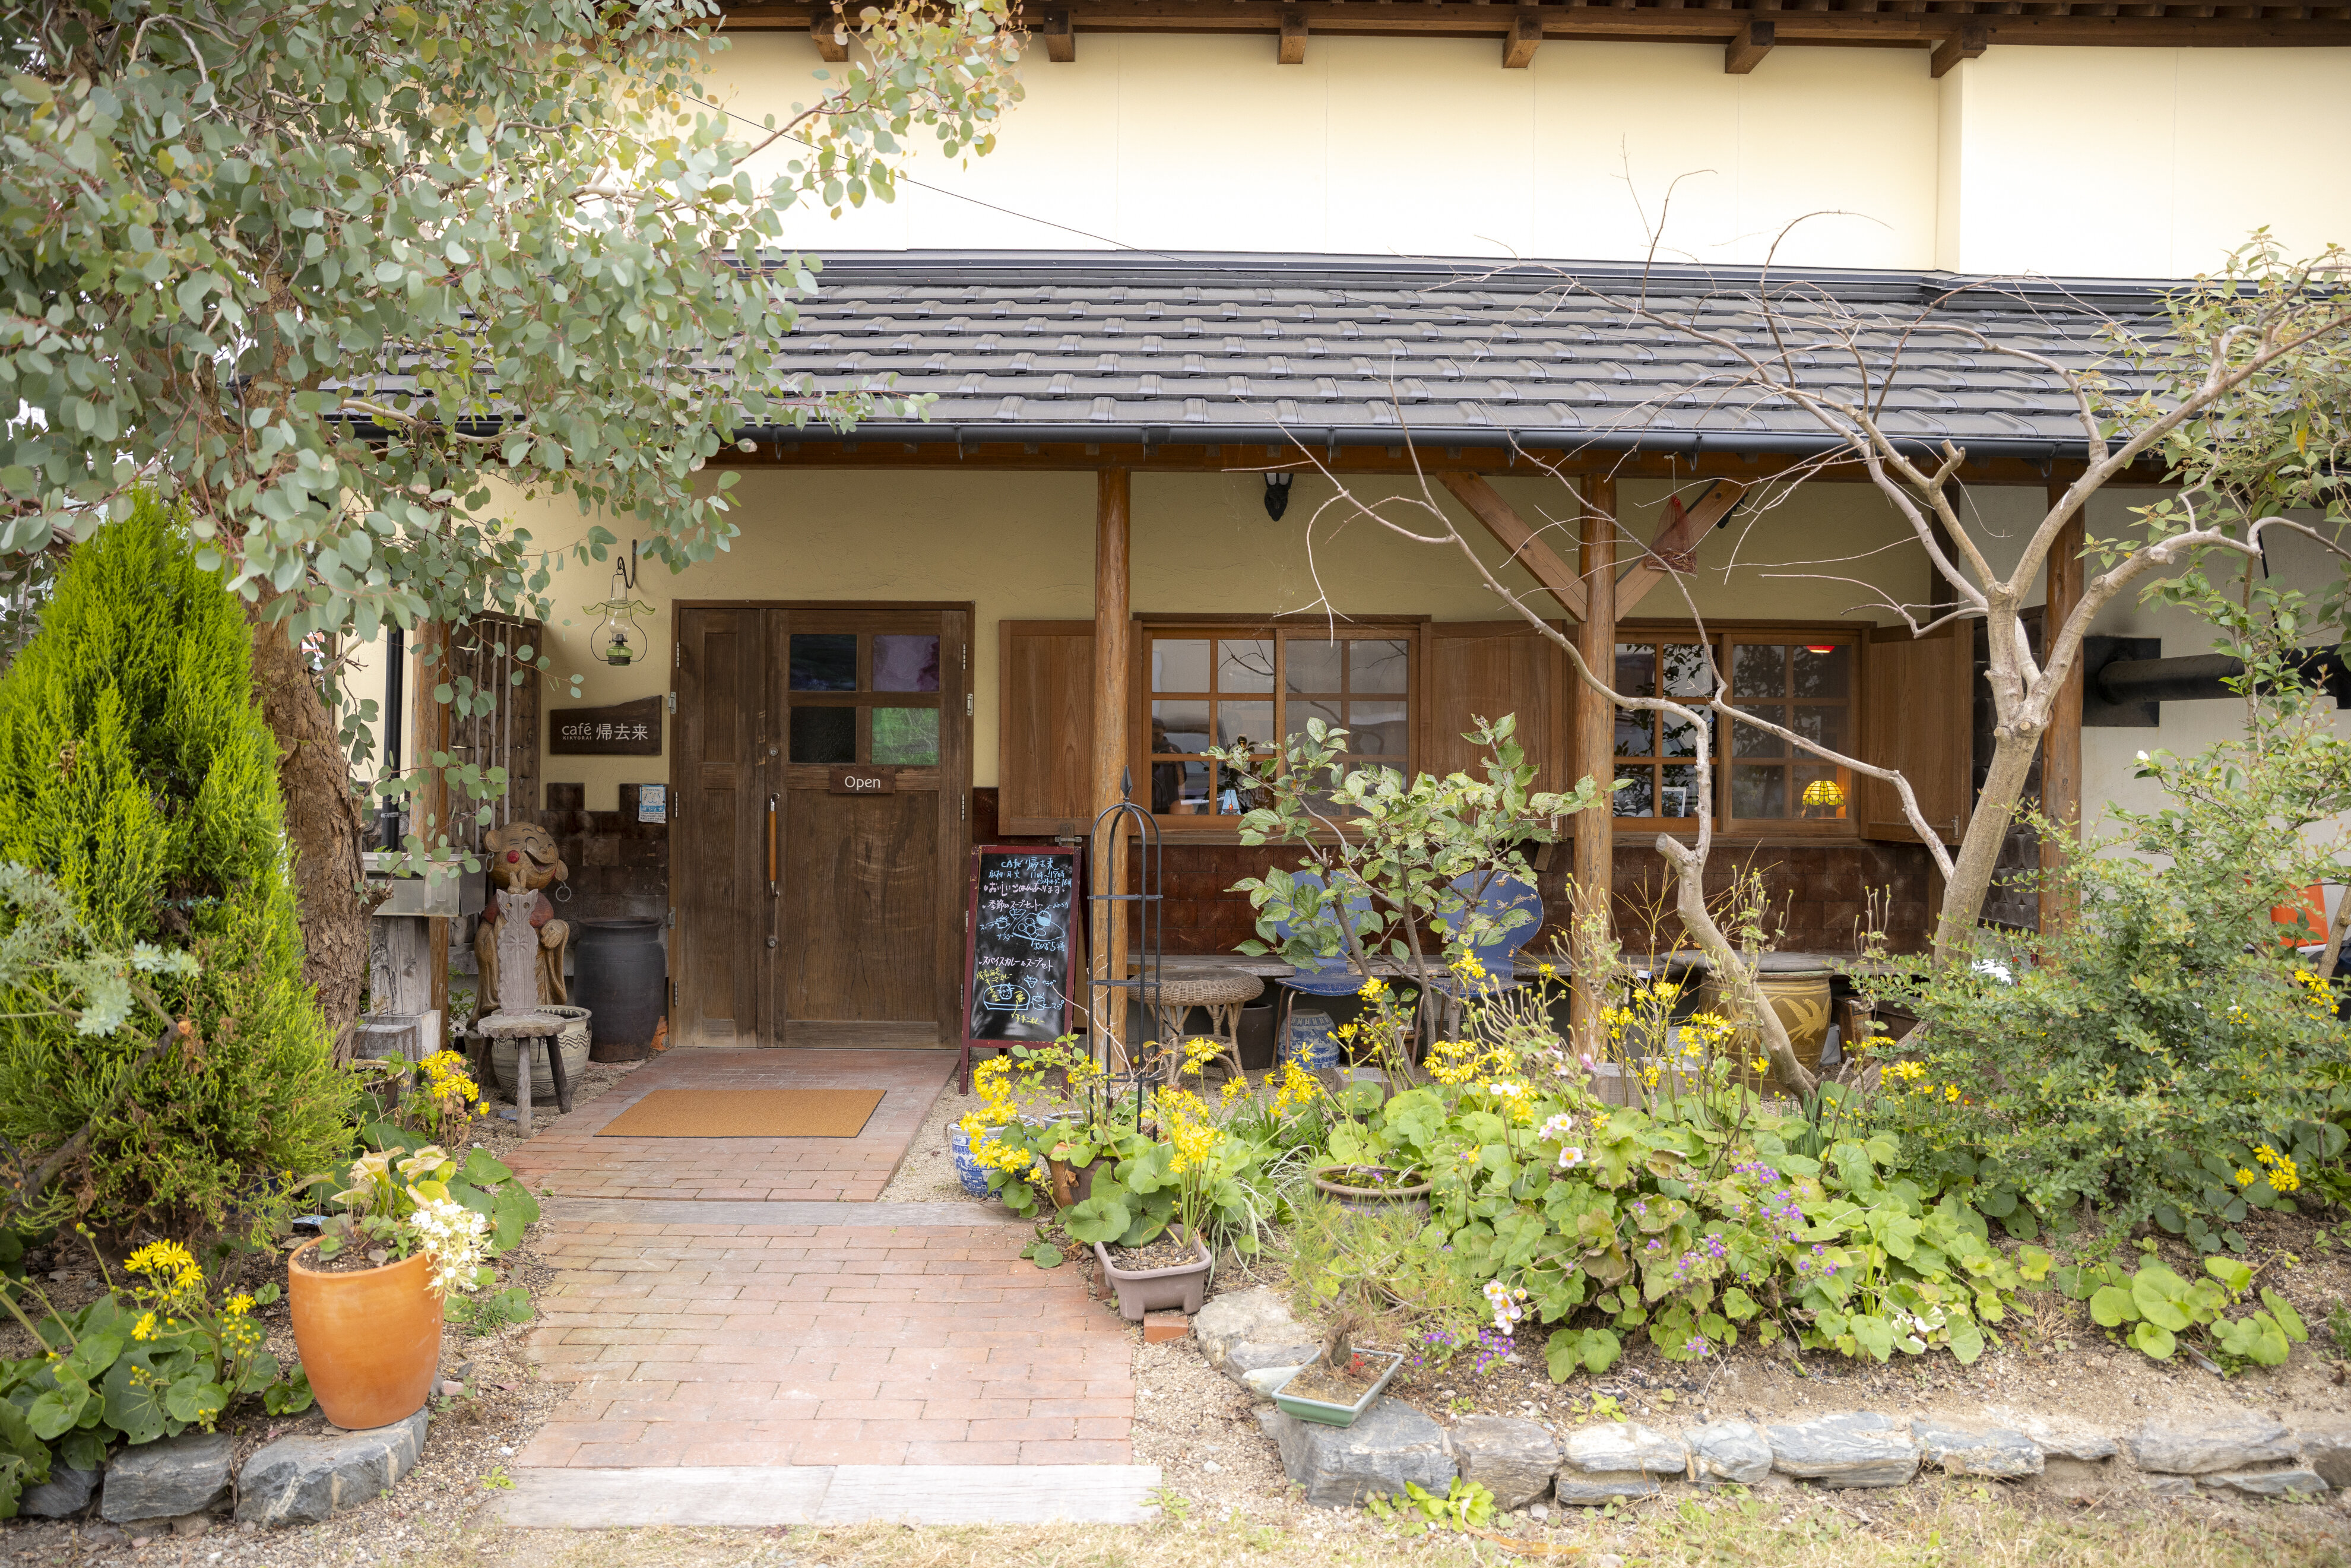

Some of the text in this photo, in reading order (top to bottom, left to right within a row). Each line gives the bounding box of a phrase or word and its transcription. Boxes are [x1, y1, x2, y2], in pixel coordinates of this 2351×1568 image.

[562, 723, 648, 740] café 帰去来
[844, 775, 880, 791] Open
[1025, 857, 1060, 875] 帰去来
